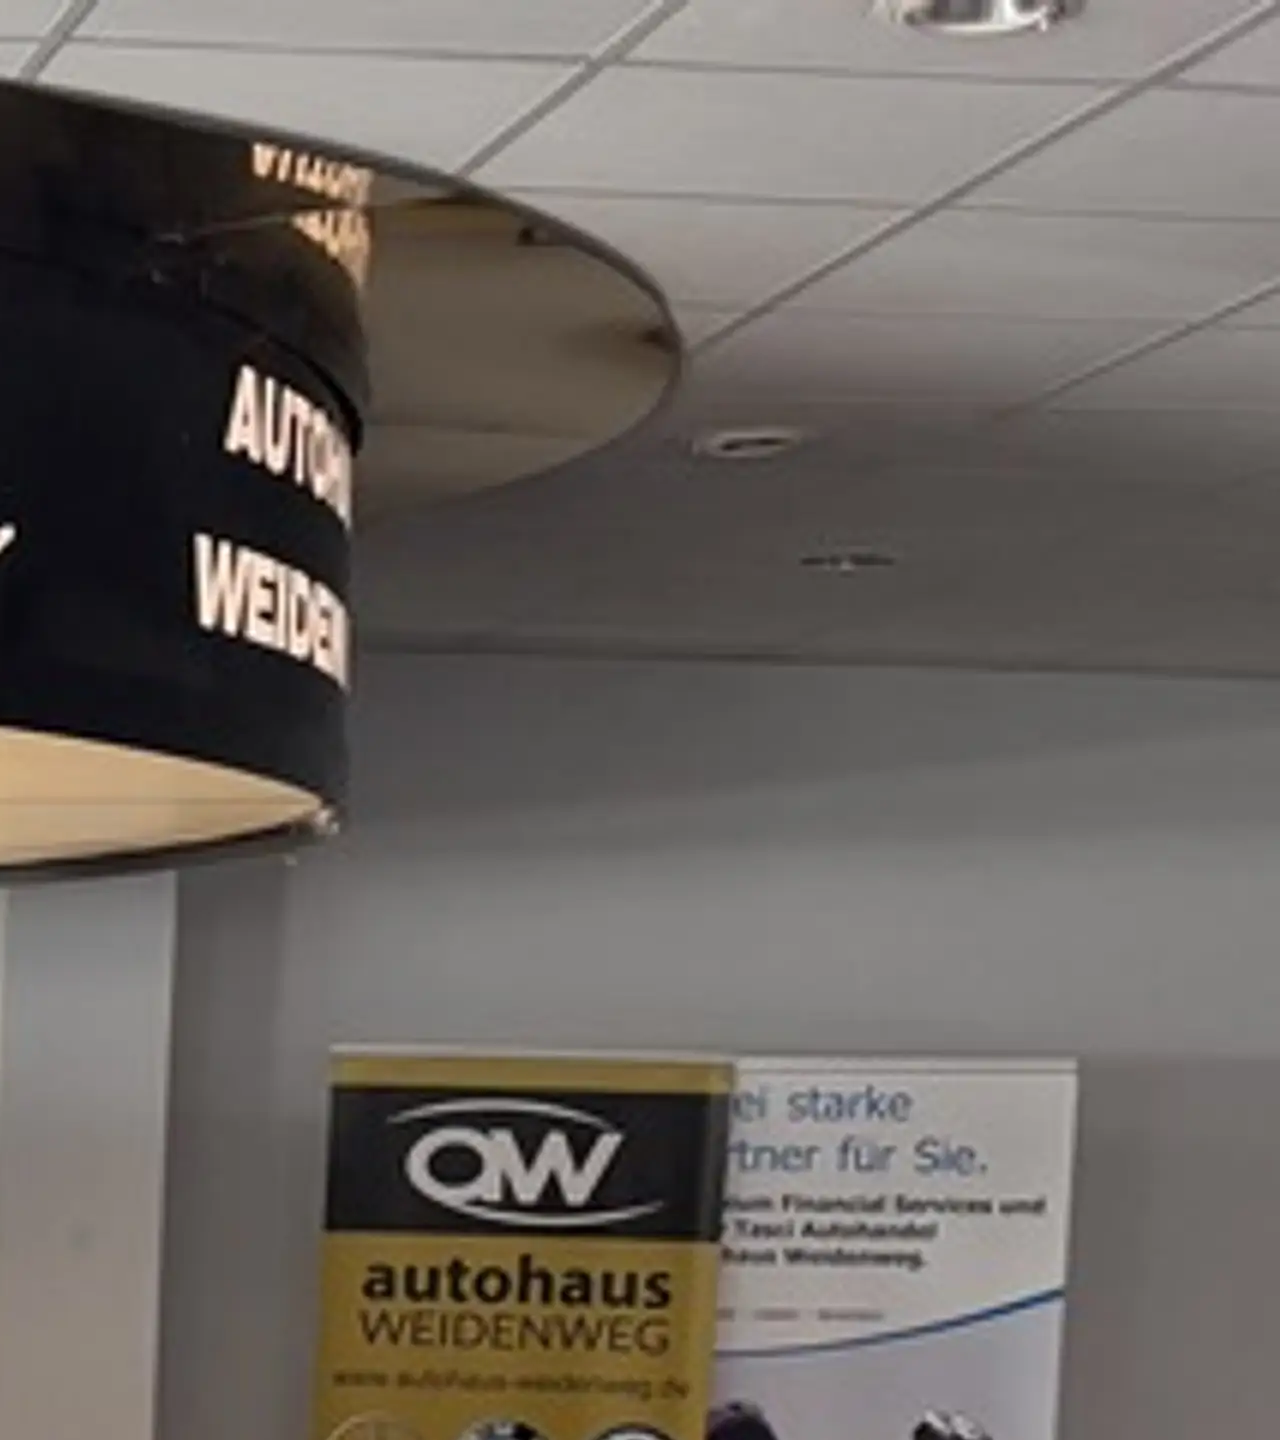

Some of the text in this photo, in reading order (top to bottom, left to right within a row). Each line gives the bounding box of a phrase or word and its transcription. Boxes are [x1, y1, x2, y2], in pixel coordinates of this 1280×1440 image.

[787, 1084, 914, 1123] starke
[360, 1254, 672, 1310] autohaus
[358, 1309, 671, 1357] WEIDENWEG
